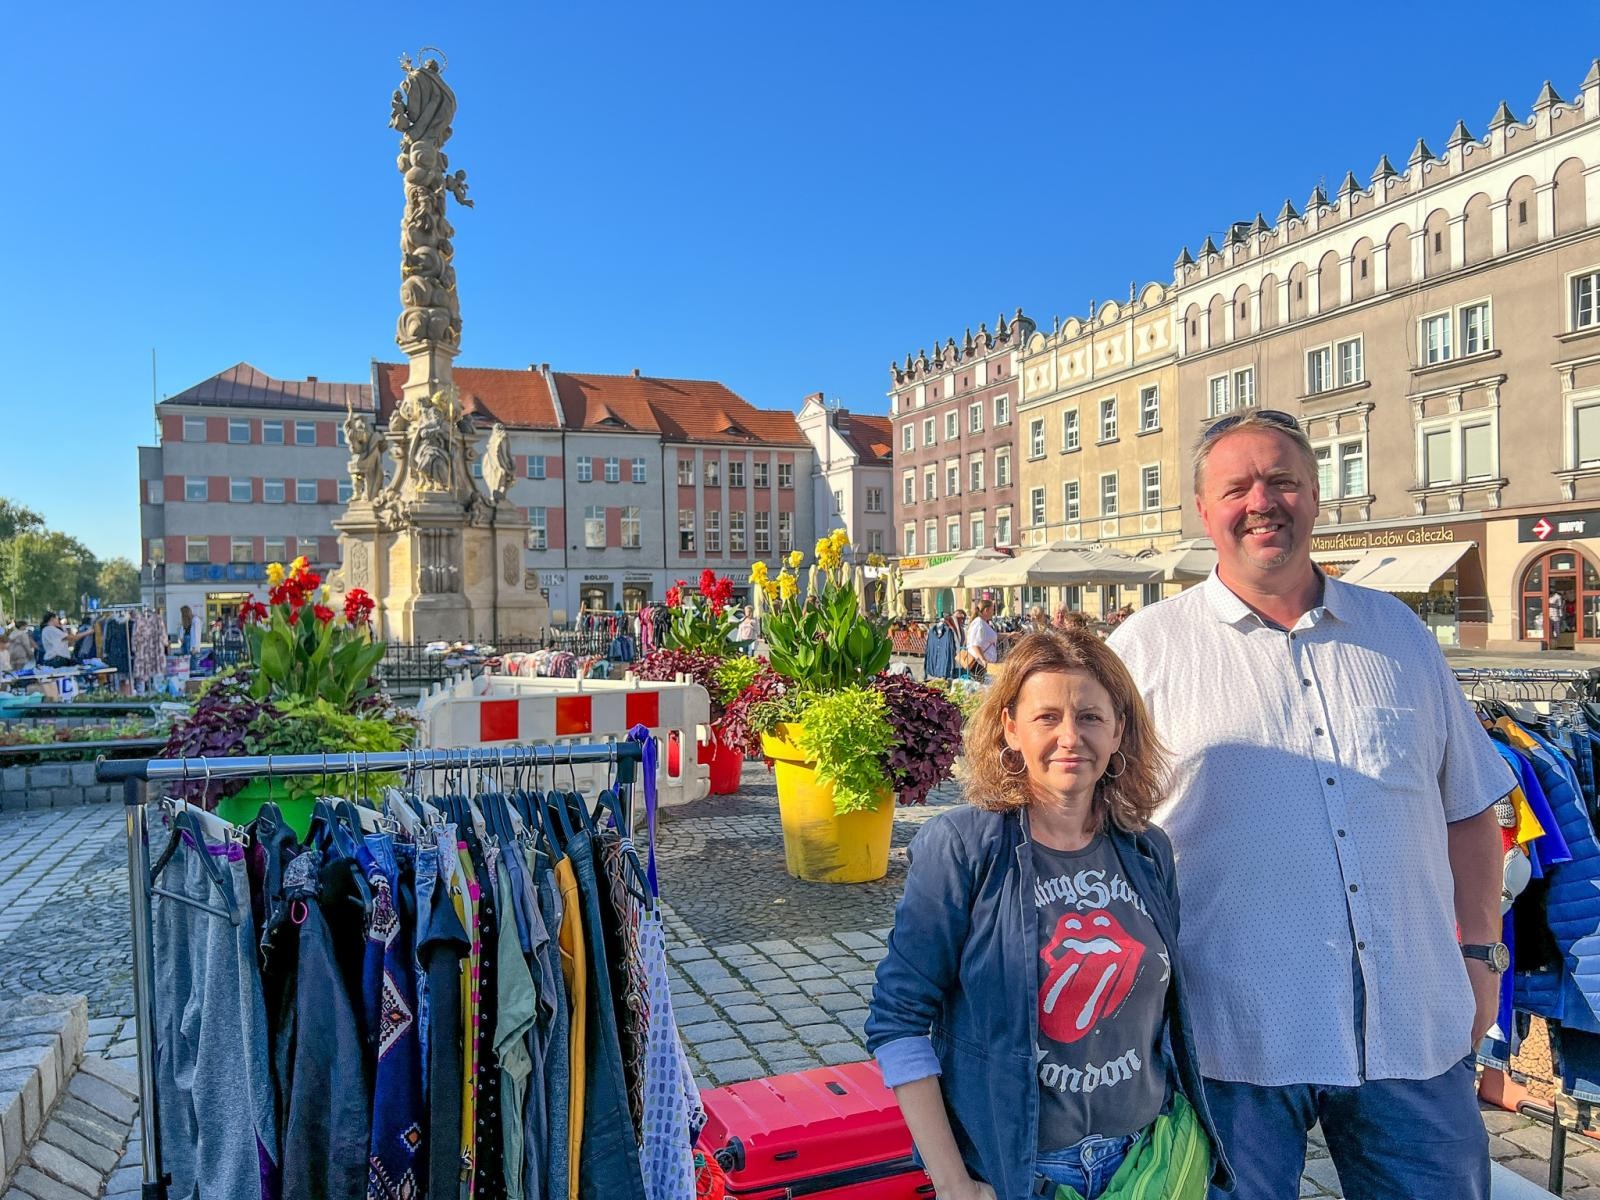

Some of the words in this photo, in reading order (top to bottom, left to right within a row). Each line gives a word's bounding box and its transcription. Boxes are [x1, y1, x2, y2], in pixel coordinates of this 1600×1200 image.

[1311, 534, 1367, 550] Manufaktura
[1370, 531, 1404, 546] Lodów
[1406, 526, 1454, 544] Gałeczka
[1040, 1048, 1142, 1093] ondon
